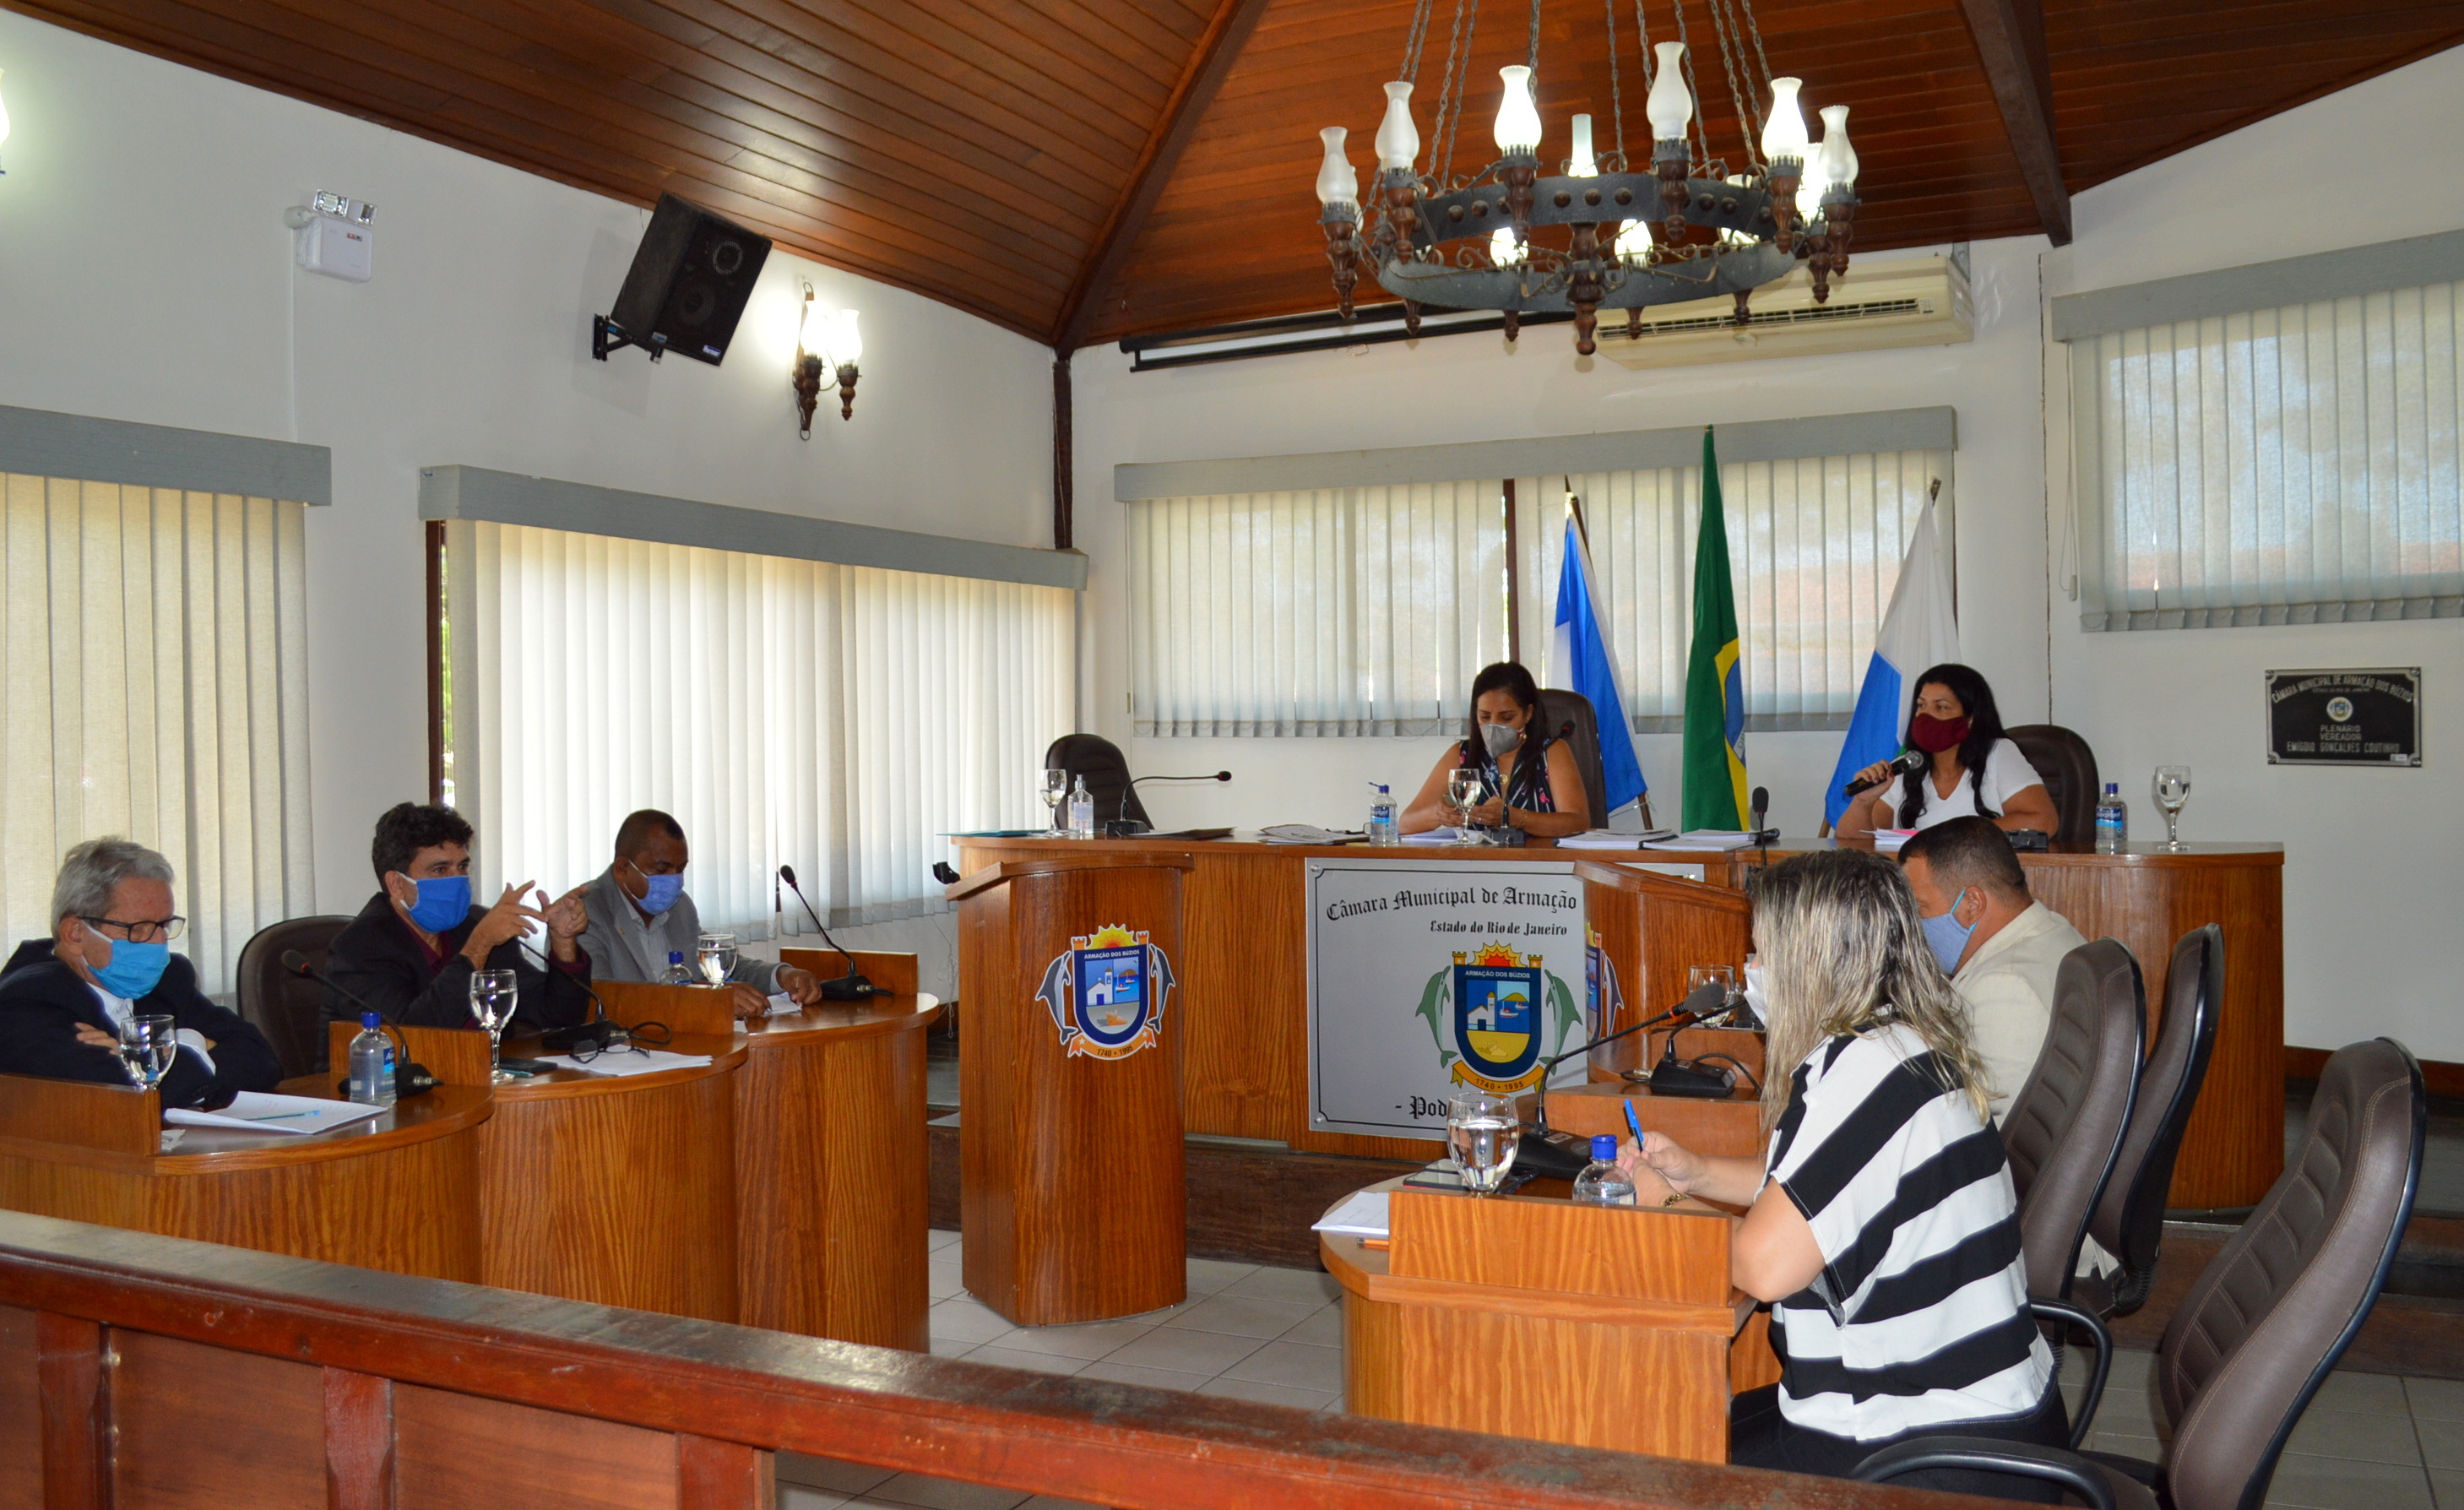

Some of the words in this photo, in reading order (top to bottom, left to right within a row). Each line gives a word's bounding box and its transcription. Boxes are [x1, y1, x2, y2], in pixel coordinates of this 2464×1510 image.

[2333, 675, 2342, 685] DE
[2320, 732, 2362, 741] VEREADOR
[1327, 897, 1387, 921] Câmara
[1393, 887, 1475, 910] Municipal
[1482, 888, 1499, 904] de
[1503, 887, 1577, 914] Armação
[1430, 921, 1467, 932] Estado
[1470, 921, 1484, 933] do
[1523, 924, 1567, 936] Janeiro
[1119, 1045, 1133, 1055] 1995
[1476, 1078, 1495, 1089] 1740
[1504, 1081, 1524, 1090] 1995
